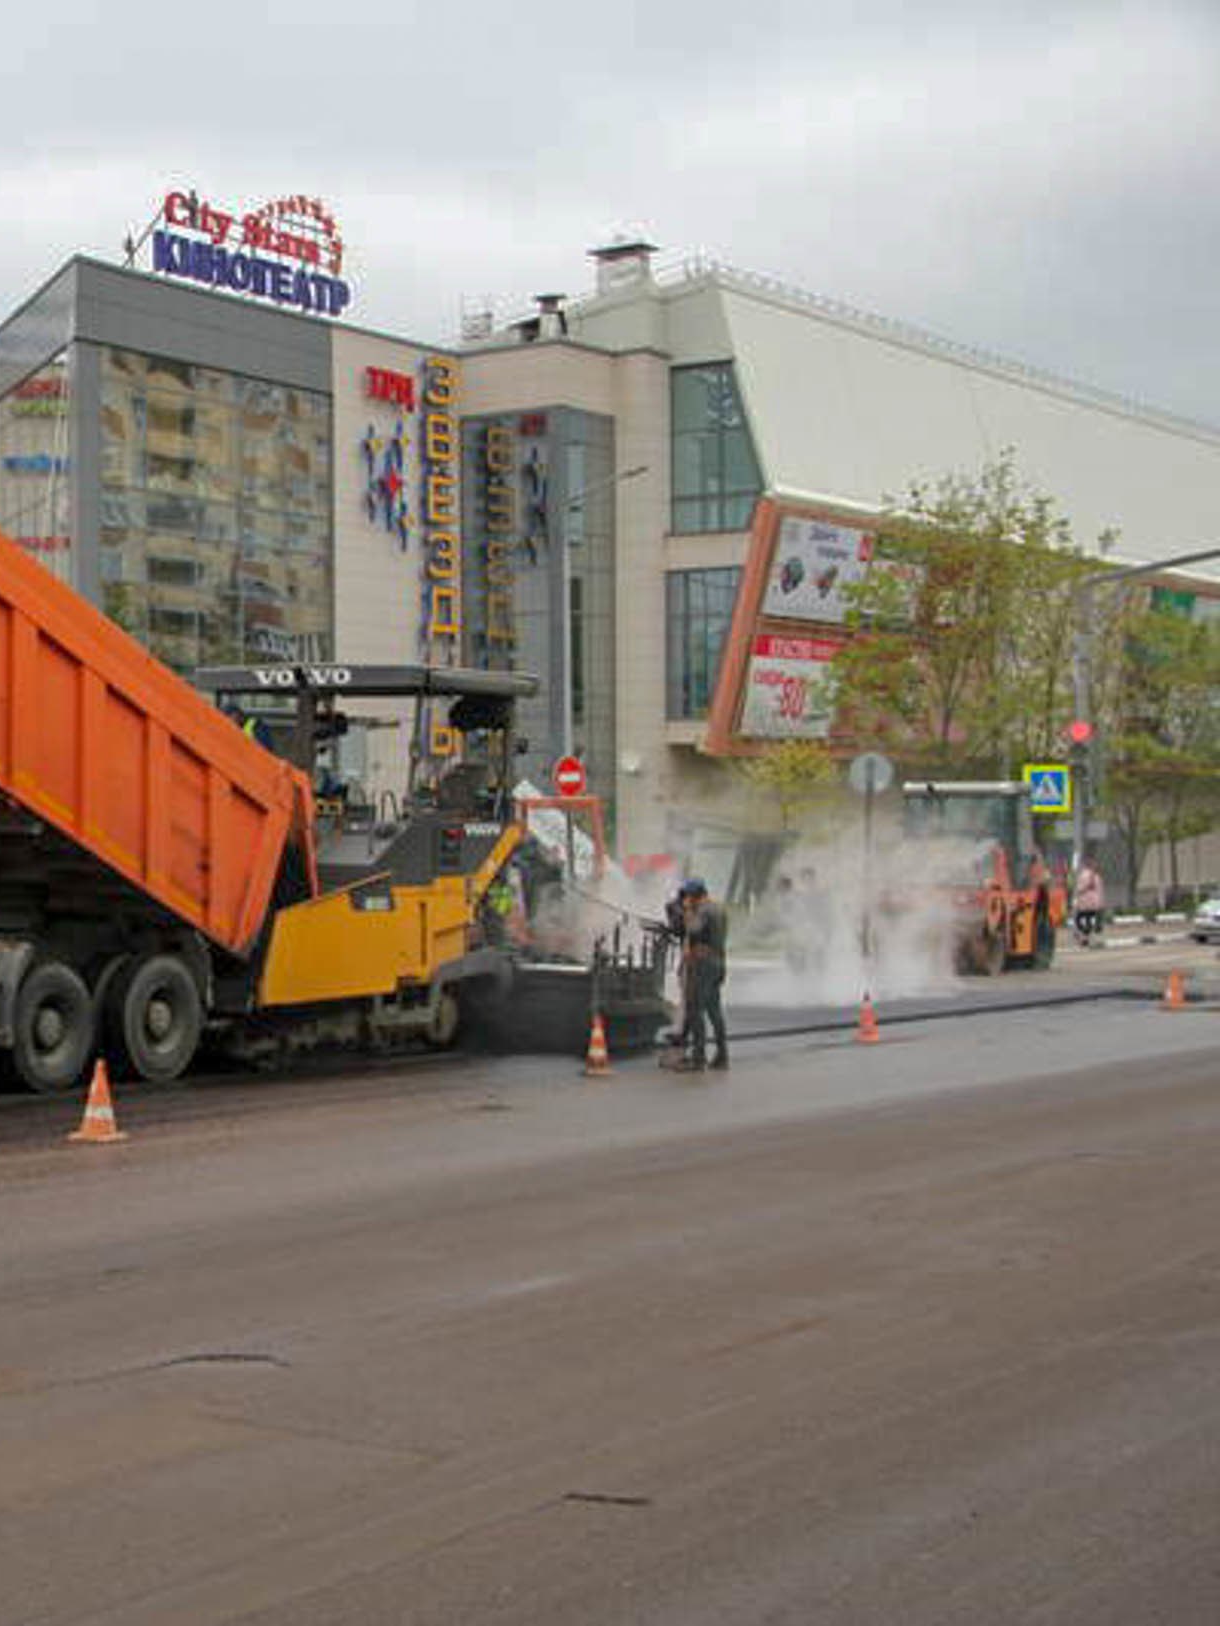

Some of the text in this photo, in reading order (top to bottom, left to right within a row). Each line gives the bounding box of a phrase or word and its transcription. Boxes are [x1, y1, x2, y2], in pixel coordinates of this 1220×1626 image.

[164, 189, 232, 244] City
[152, 229, 352, 316] КИНОТЕАТР
[365, 366, 415, 413] ТРЦ
